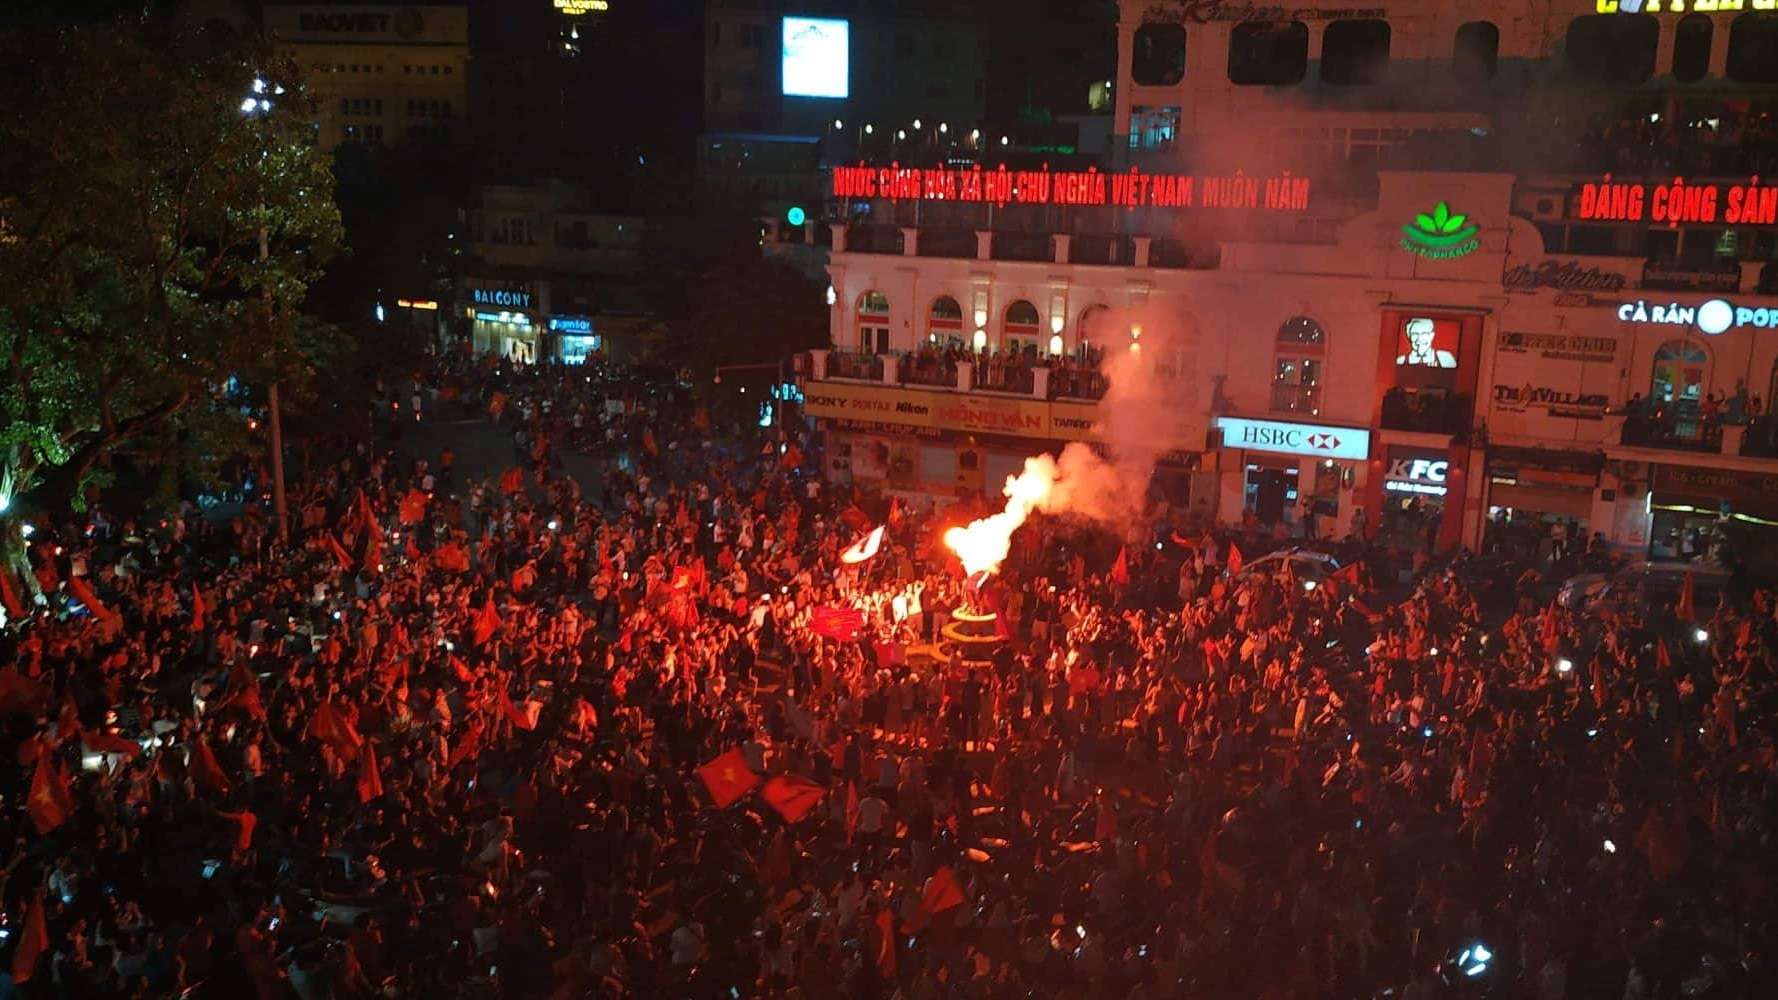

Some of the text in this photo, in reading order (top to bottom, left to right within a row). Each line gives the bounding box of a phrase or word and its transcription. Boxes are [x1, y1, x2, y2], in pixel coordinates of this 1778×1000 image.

[833, 160, 876, 197] NƯỚC
[880, 161, 921, 206] CỘNG
[960, 164, 981, 201] XÃ
[986, 163, 1012, 208] HỘI
[1016, 162, 1049, 202] CHỦ
[1054, 165, 1105, 204] NGHĨA
[1112, 165, 1149, 211] VIỆT
[1152, 175, 1193, 207] NAM
[1203, 168, 1258, 208] MUÔN
[1264, 169, 1310, 208] NĂM
[1580, 172, 1778, 228] ĐẢNG CỘNG SẢN
[475, 289, 530, 307] BALCONY
[1652, 302, 1695, 324] RÁN
[895, 401, 928, 415] Nikon
[1243, 426, 1301, 447] HSBC
[1384, 459, 1449, 482] KFC
